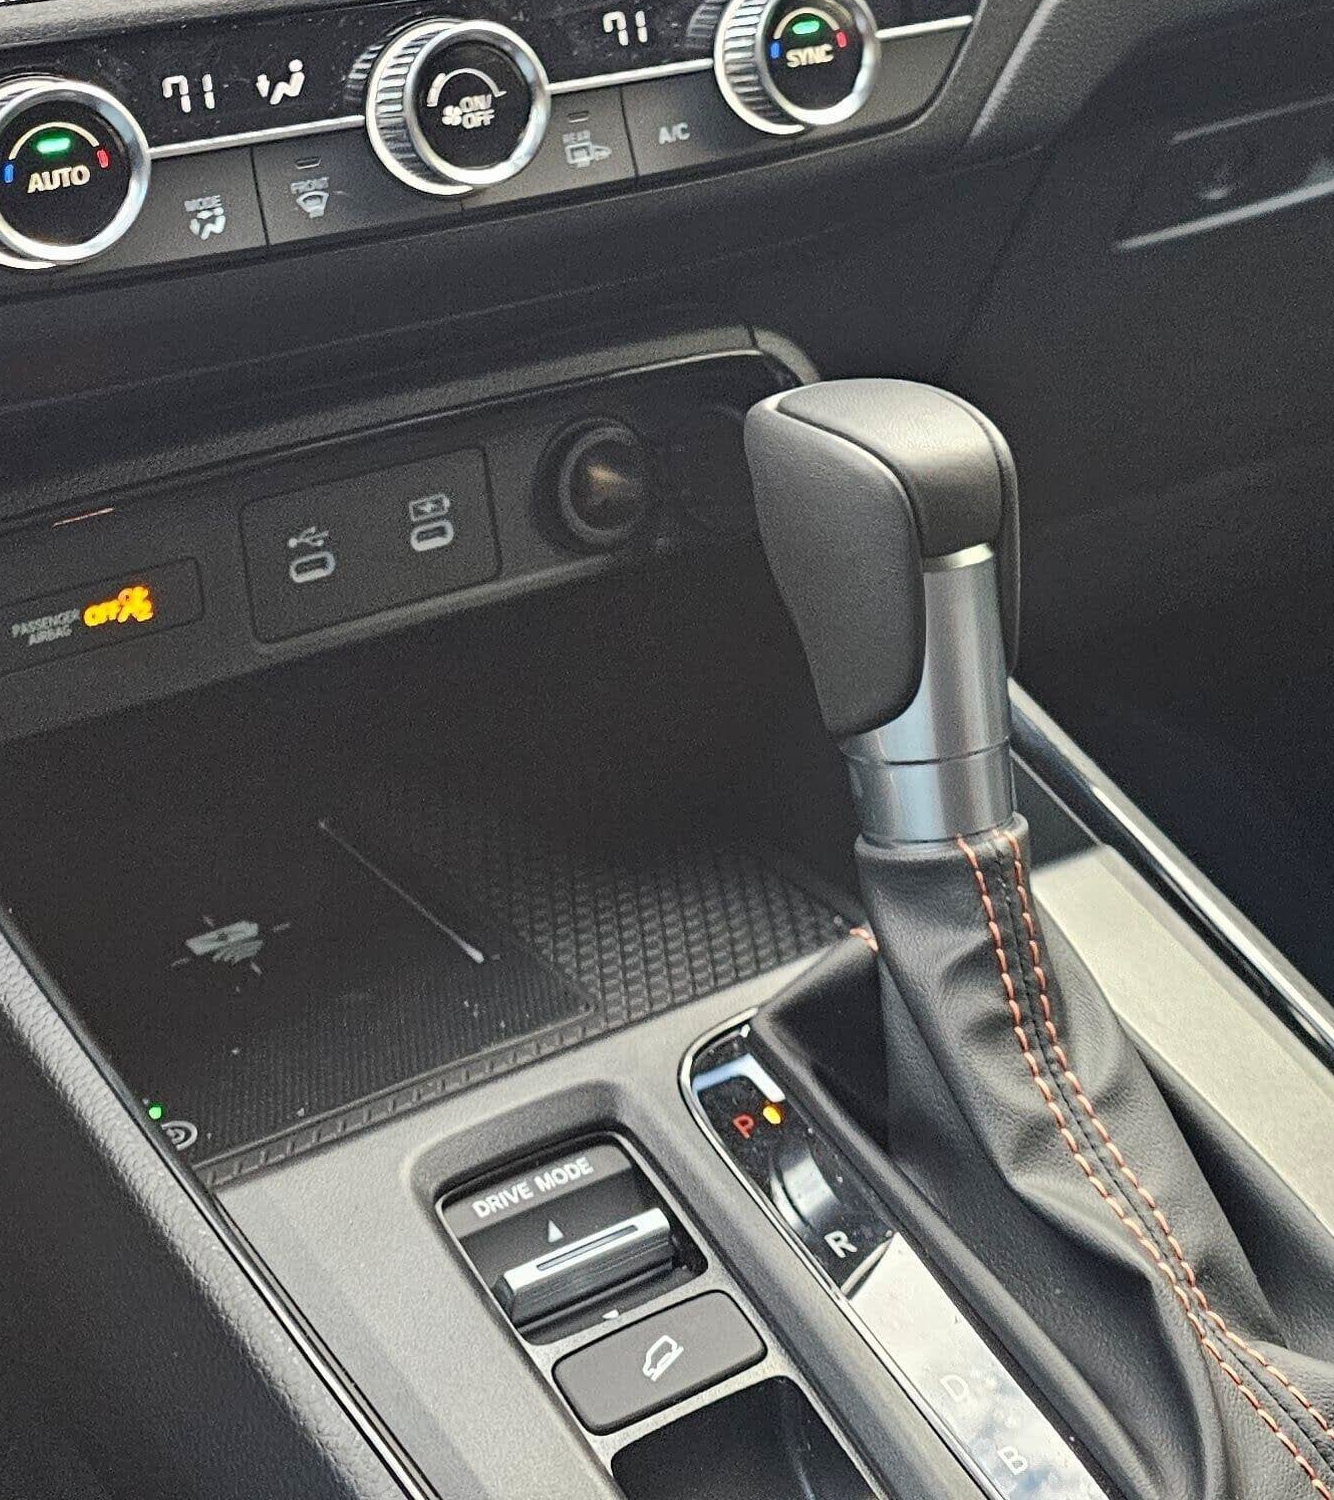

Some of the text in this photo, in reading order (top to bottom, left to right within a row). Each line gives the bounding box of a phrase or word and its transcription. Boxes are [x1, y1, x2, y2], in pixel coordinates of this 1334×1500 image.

[601, 11, 647, 45] 71
[786, 44, 832, 67] SYNC
[162, 74, 214, 112] 71
[461, 109, 495, 129] OFF
[658, 122, 690, 145] A/C
[27, 164, 90, 194] AUTO
[11, 608, 81, 638] PASSENGER
[28, 624, 72, 645] AIRBAG
[733, 1114, 755, 1138] P
[472, 1157, 594, 1218] DRIVE MODE
[824, 1230, 858, 1259] R
